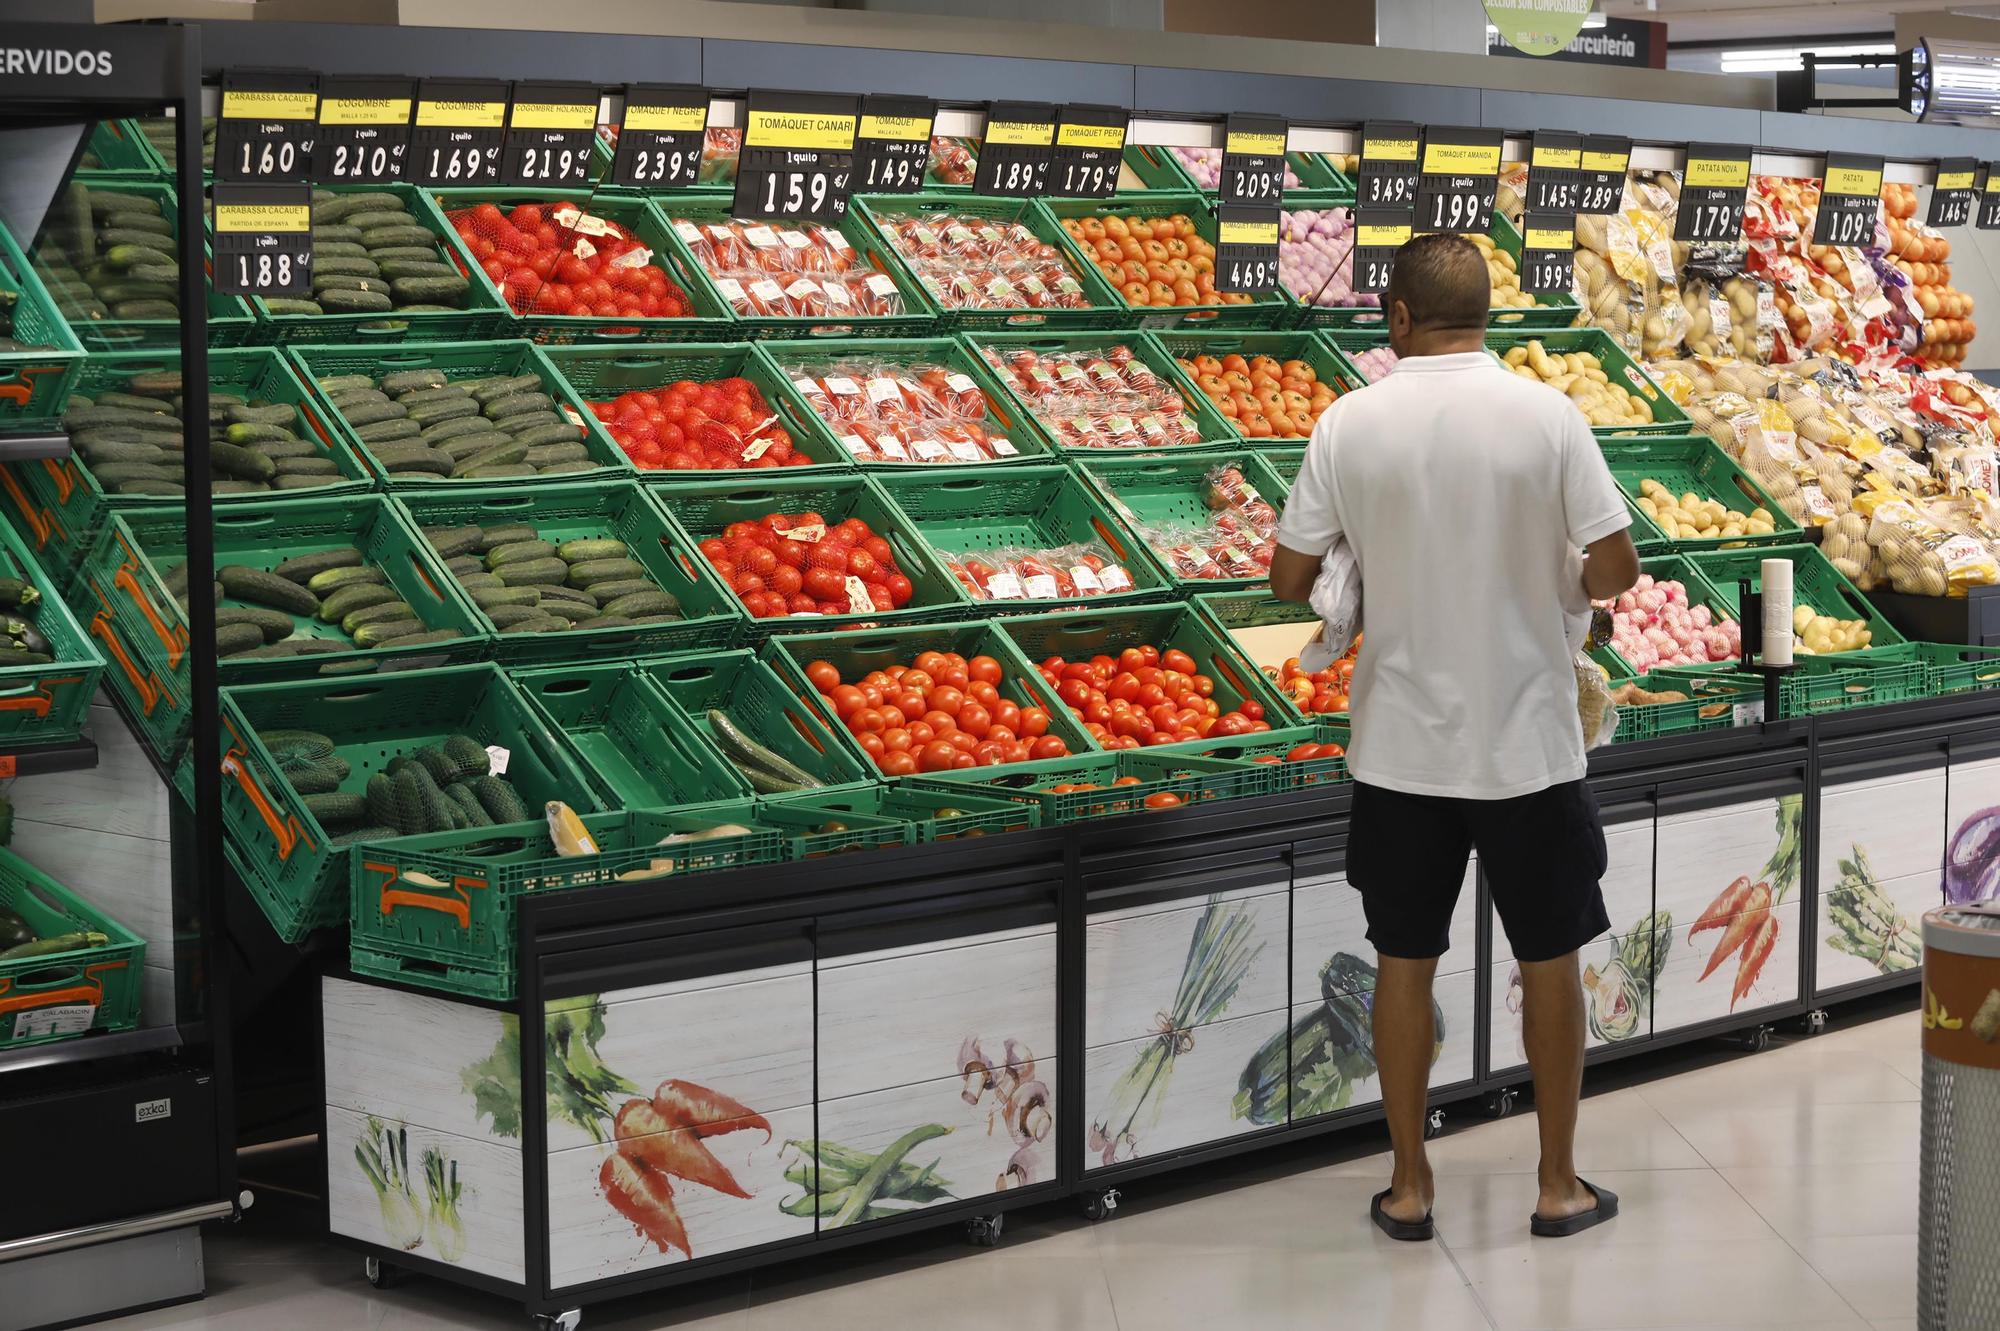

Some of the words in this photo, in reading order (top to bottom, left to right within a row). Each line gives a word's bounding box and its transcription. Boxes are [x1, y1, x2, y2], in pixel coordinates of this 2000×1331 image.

[1534, 0, 1588, 14] COMPOSTABLES
[229, 92, 276, 102] CARABASSA
[277, 95, 313, 103] CACAUET
[337, 98, 391, 108] COGOMBRE
[435, 101, 486, 111] COGOMBRE
[516, 104, 554, 112] COGOMBRE
[672, 107, 702, 116] NEGRE
[266, 124, 284, 134] quilo
[759, 116, 815, 130] TOMÀQUET
[816, 120, 854, 132] CANARI
[360, 129, 378, 140] quilo
[455, 132, 472, 142] quilo
[548, 134, 564, 143] quilo
[660, 135, 675, 144] quilo
[794, 152, 818, 164] quilo
[1697, 164, 1720, 172] PATATA
[1456, 178, 1474, 188] quilo
[1843, 174, 1864, 182] PATATA
[1712, 190, 1726, 200] quilo
[834, 198, 845, 213] kg
[138, 1101, 168, 1116] exkal
